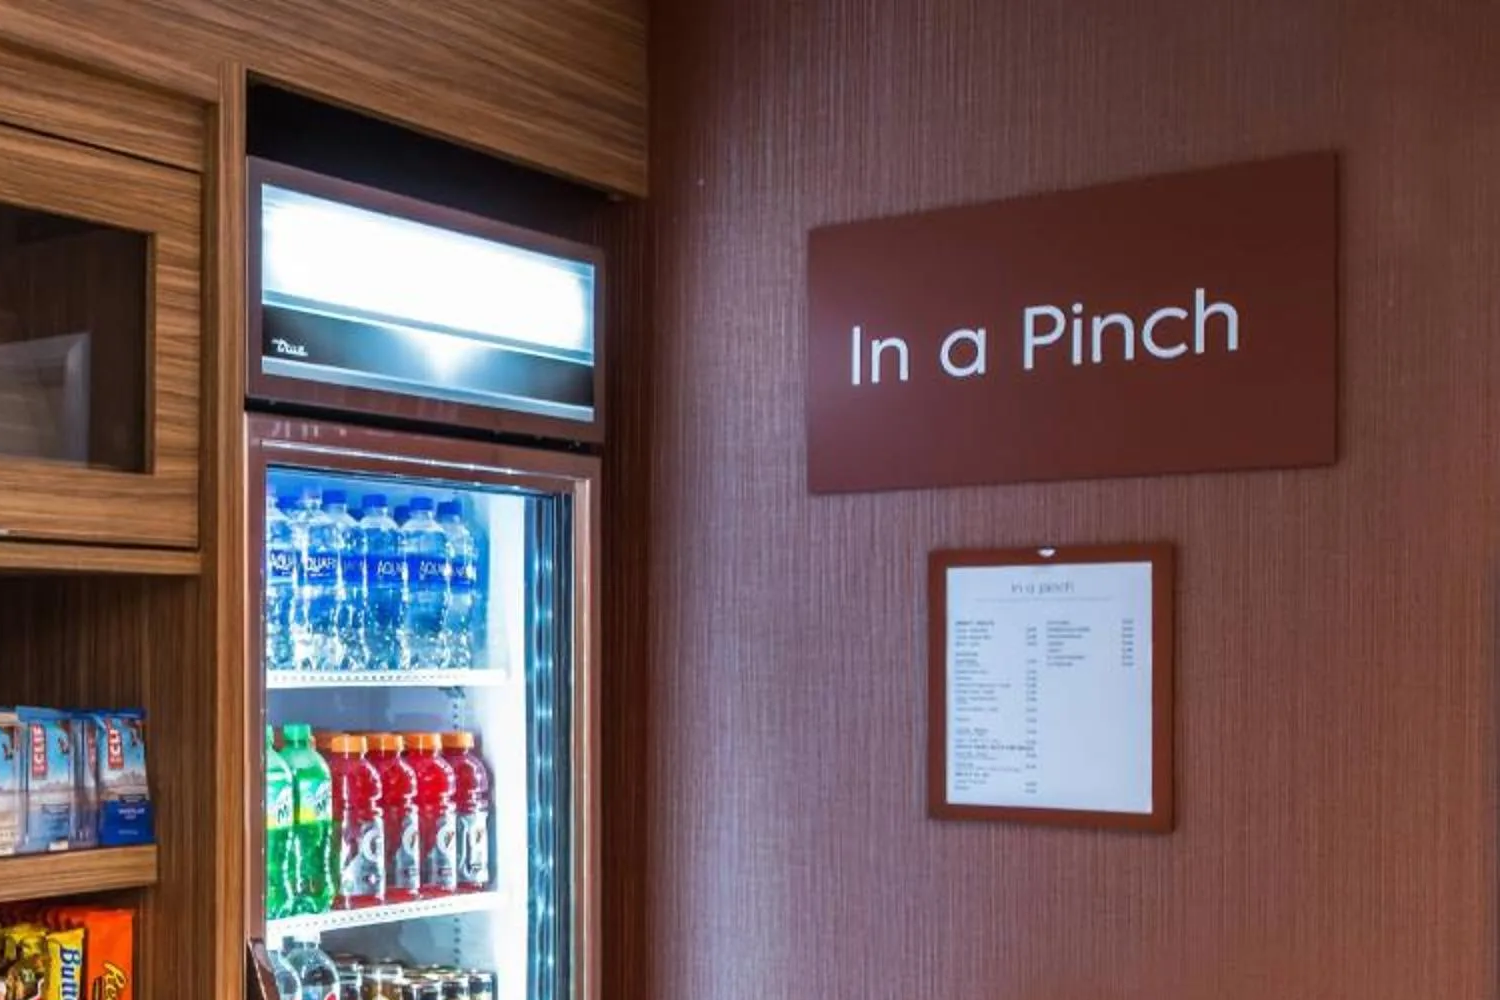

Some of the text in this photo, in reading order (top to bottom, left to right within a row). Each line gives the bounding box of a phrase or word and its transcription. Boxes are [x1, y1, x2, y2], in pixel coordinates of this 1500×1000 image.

[851, 287, 1239, 386] In a Pinch
